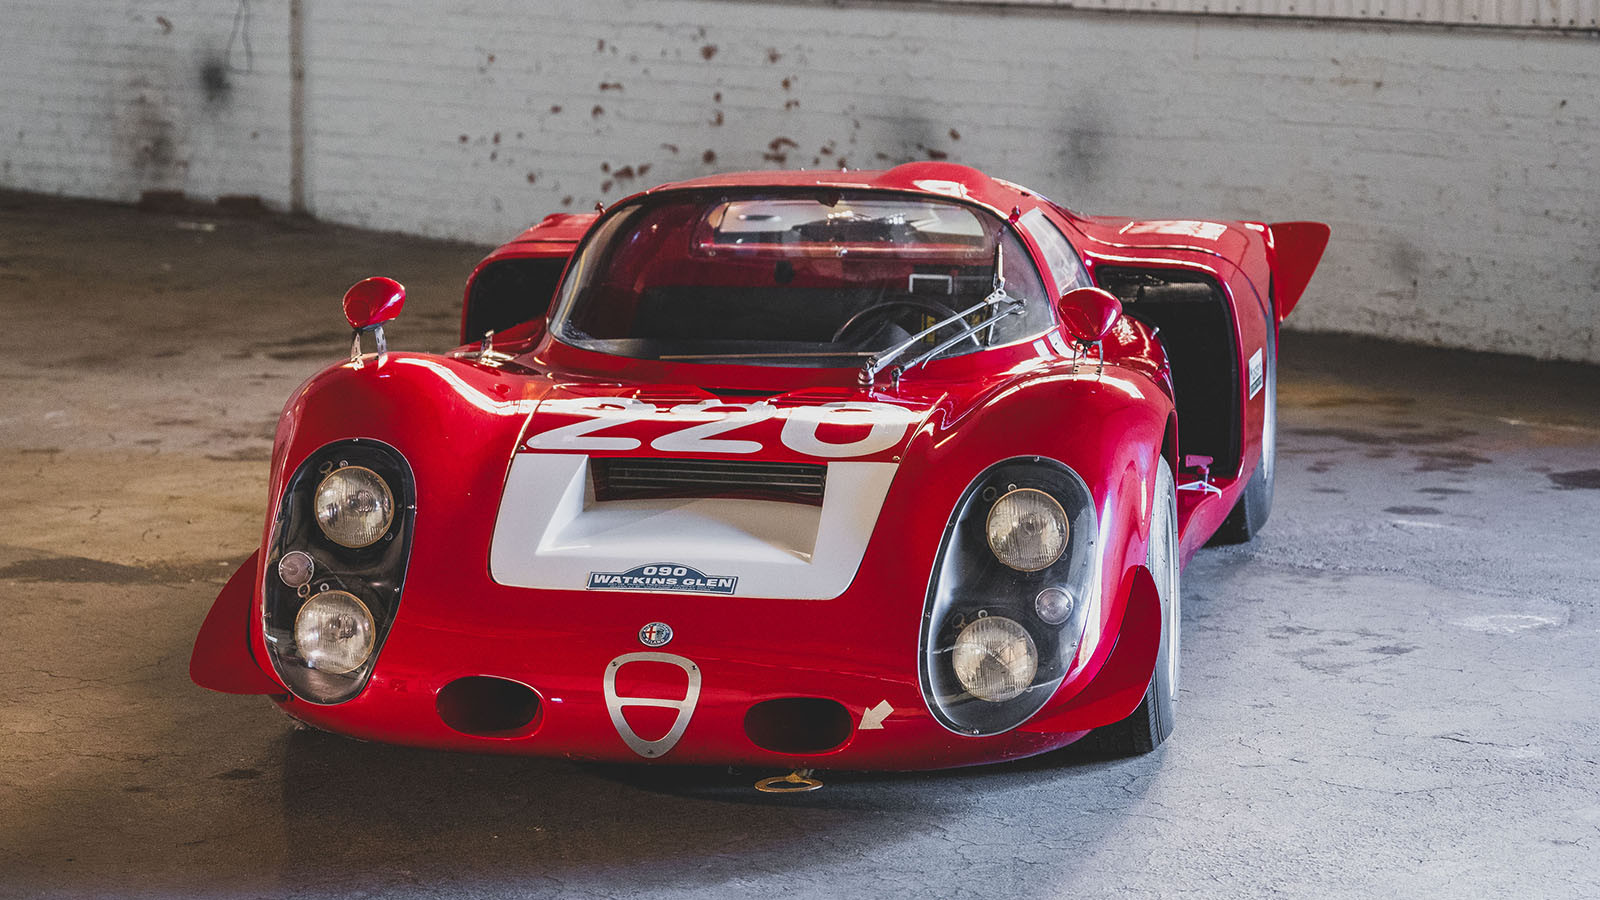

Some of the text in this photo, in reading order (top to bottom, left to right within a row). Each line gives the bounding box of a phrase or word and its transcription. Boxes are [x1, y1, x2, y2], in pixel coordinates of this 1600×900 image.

[526, 396, 910, 458] 220
[643, 566, 688, 576] 090
[594, 574, 678, 584] WATKINS
[682, 578, 733, 588] GLEN
